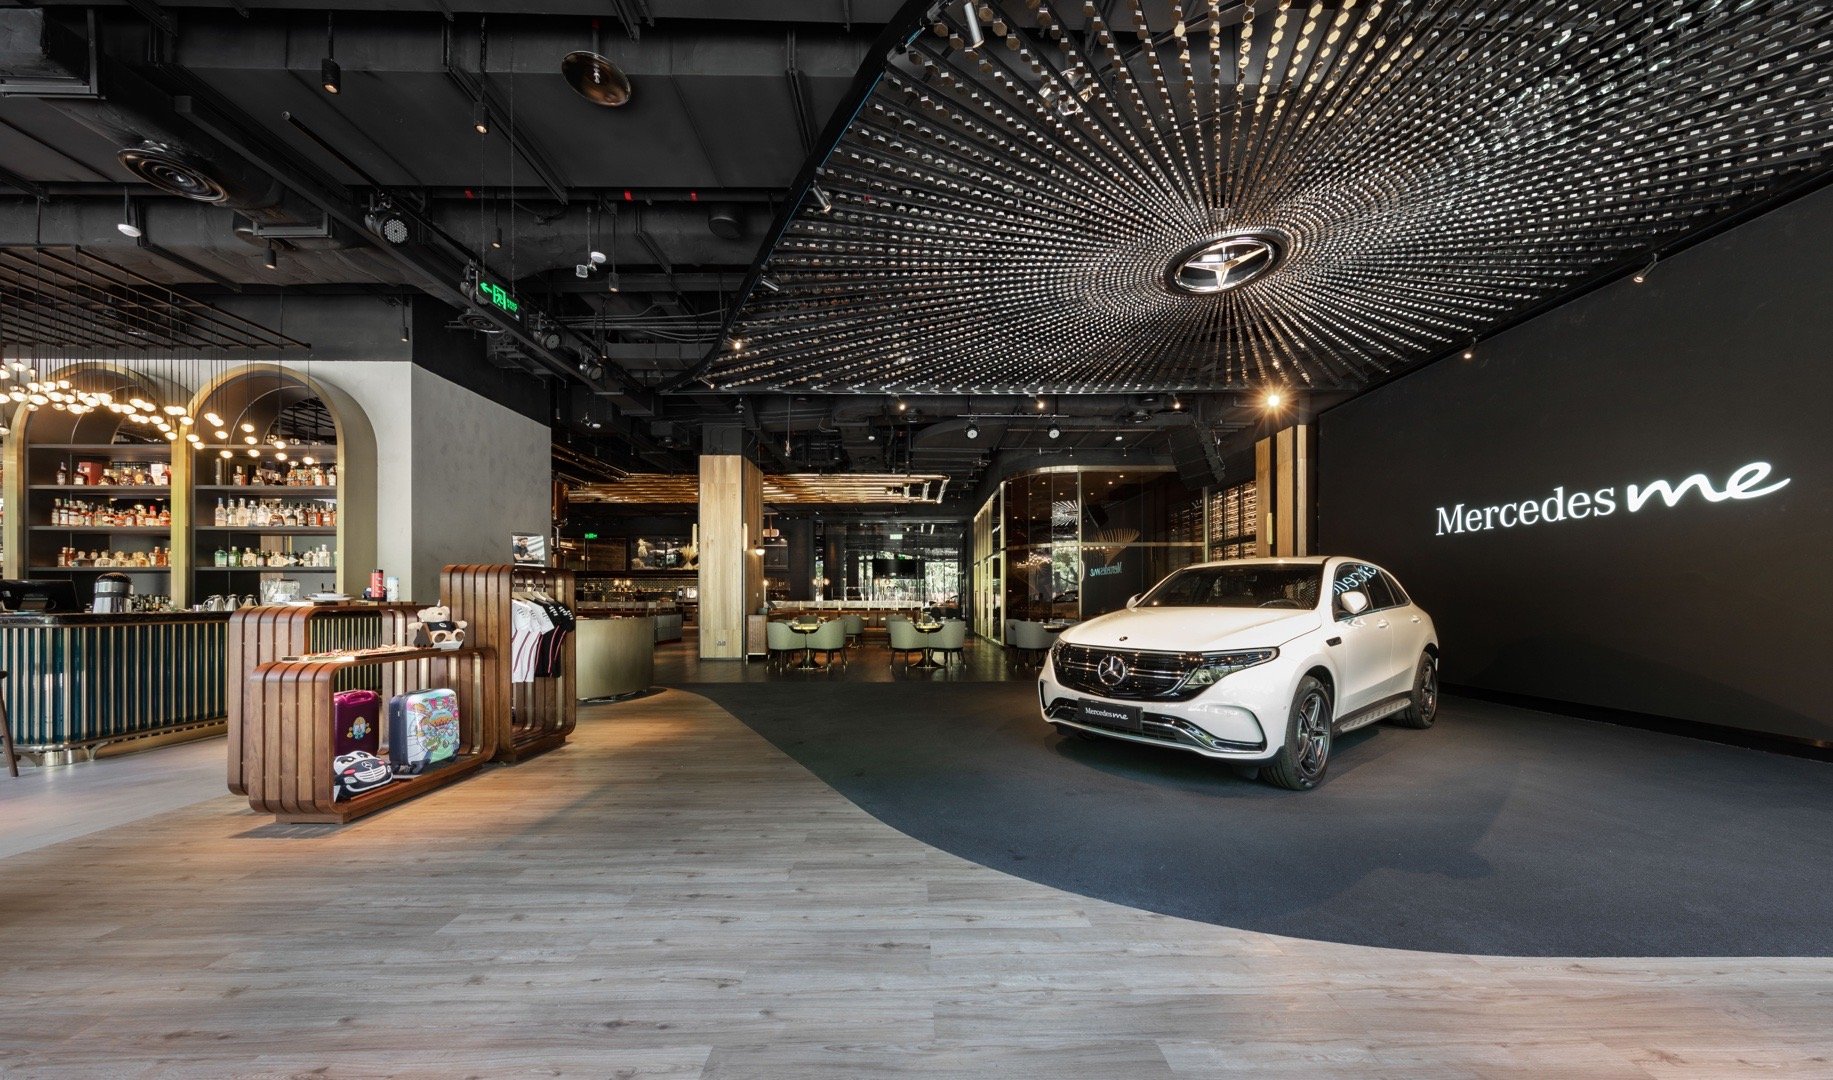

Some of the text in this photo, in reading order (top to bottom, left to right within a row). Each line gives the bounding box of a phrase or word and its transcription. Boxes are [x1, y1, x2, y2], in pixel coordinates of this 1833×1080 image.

[1435, 461, 1791, 536] Mercedes me
[1085, 707, 1129, 720] Mercedes me
